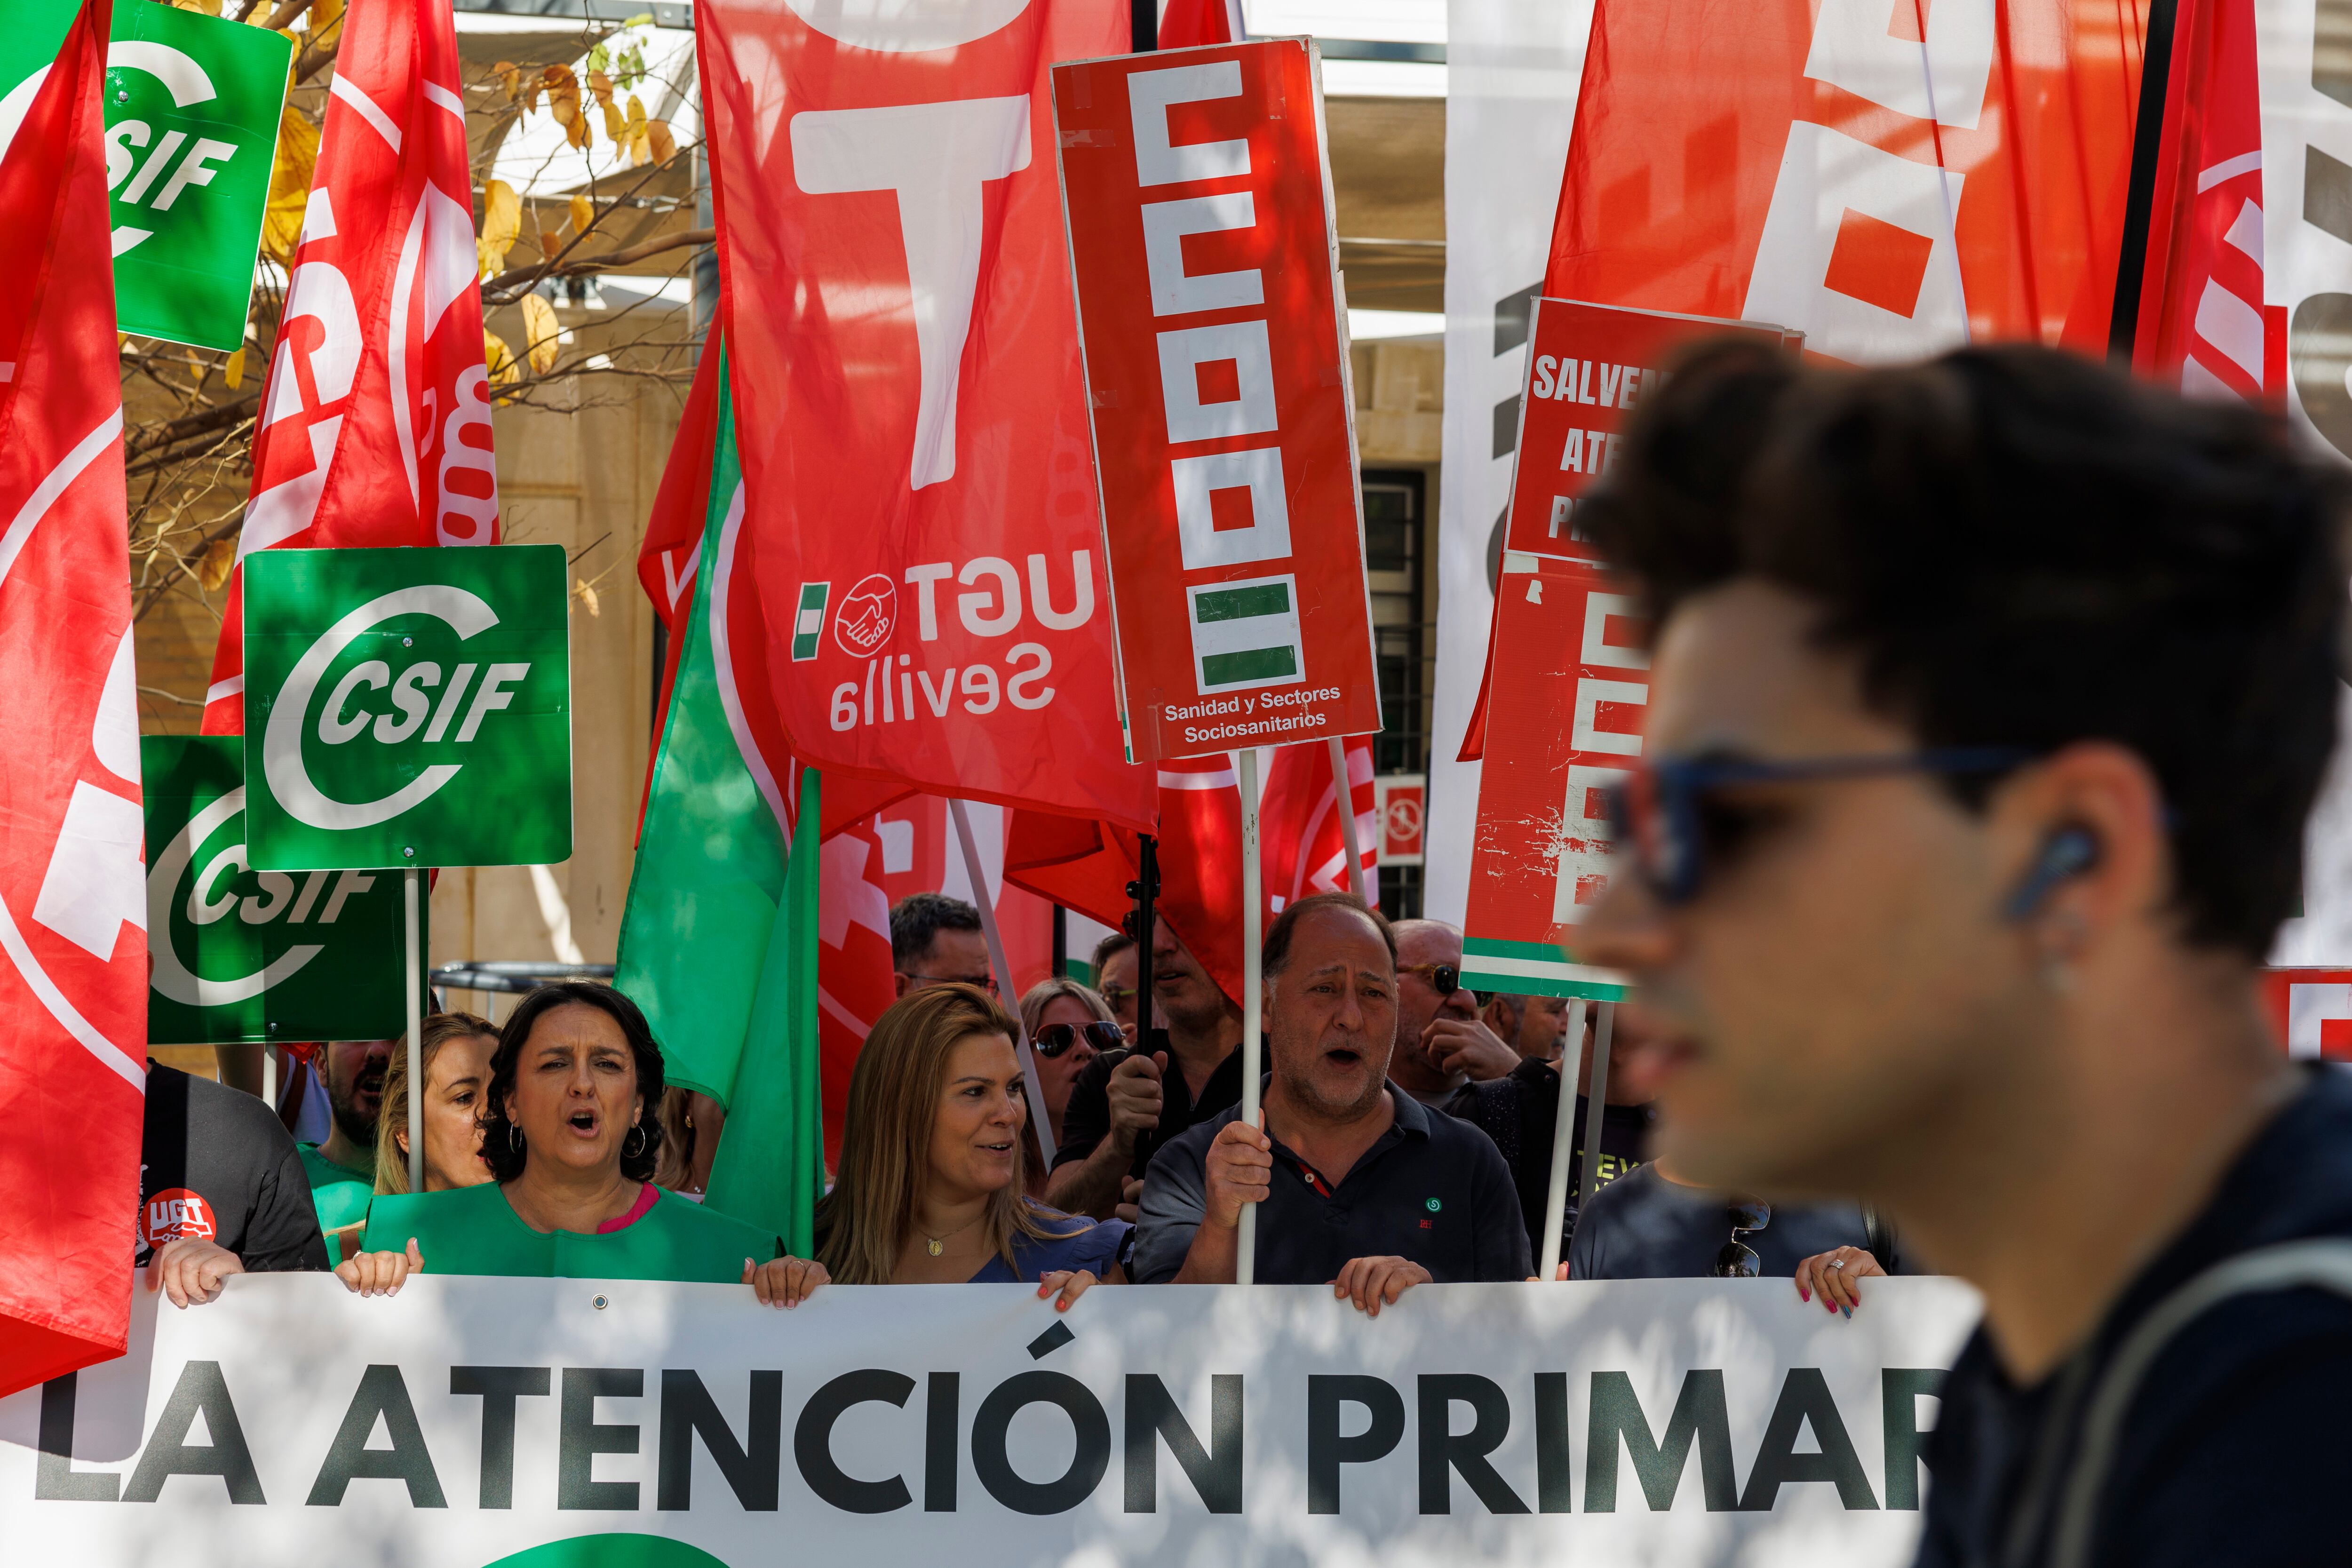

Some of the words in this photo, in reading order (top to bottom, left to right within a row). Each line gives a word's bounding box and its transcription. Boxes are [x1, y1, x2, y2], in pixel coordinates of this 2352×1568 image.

[103, 119, 239, 211] SIF
[1127, 60, 1293, 570] CCOO
[318, 660, 531, 745] CSIF
[1165, 697, 1240, 721] Sanidad
[1245, 698, 1256, 715] y
[1260, 686, 1341, 709] Sectores
[1184, 711, 1326, 743] Sociosanitarios
[150, 1198, 205, 1229] UGT
[34, 1360, 267, 1504] LA
[304, 1318, 1244, 1516] ATENCIÓN
